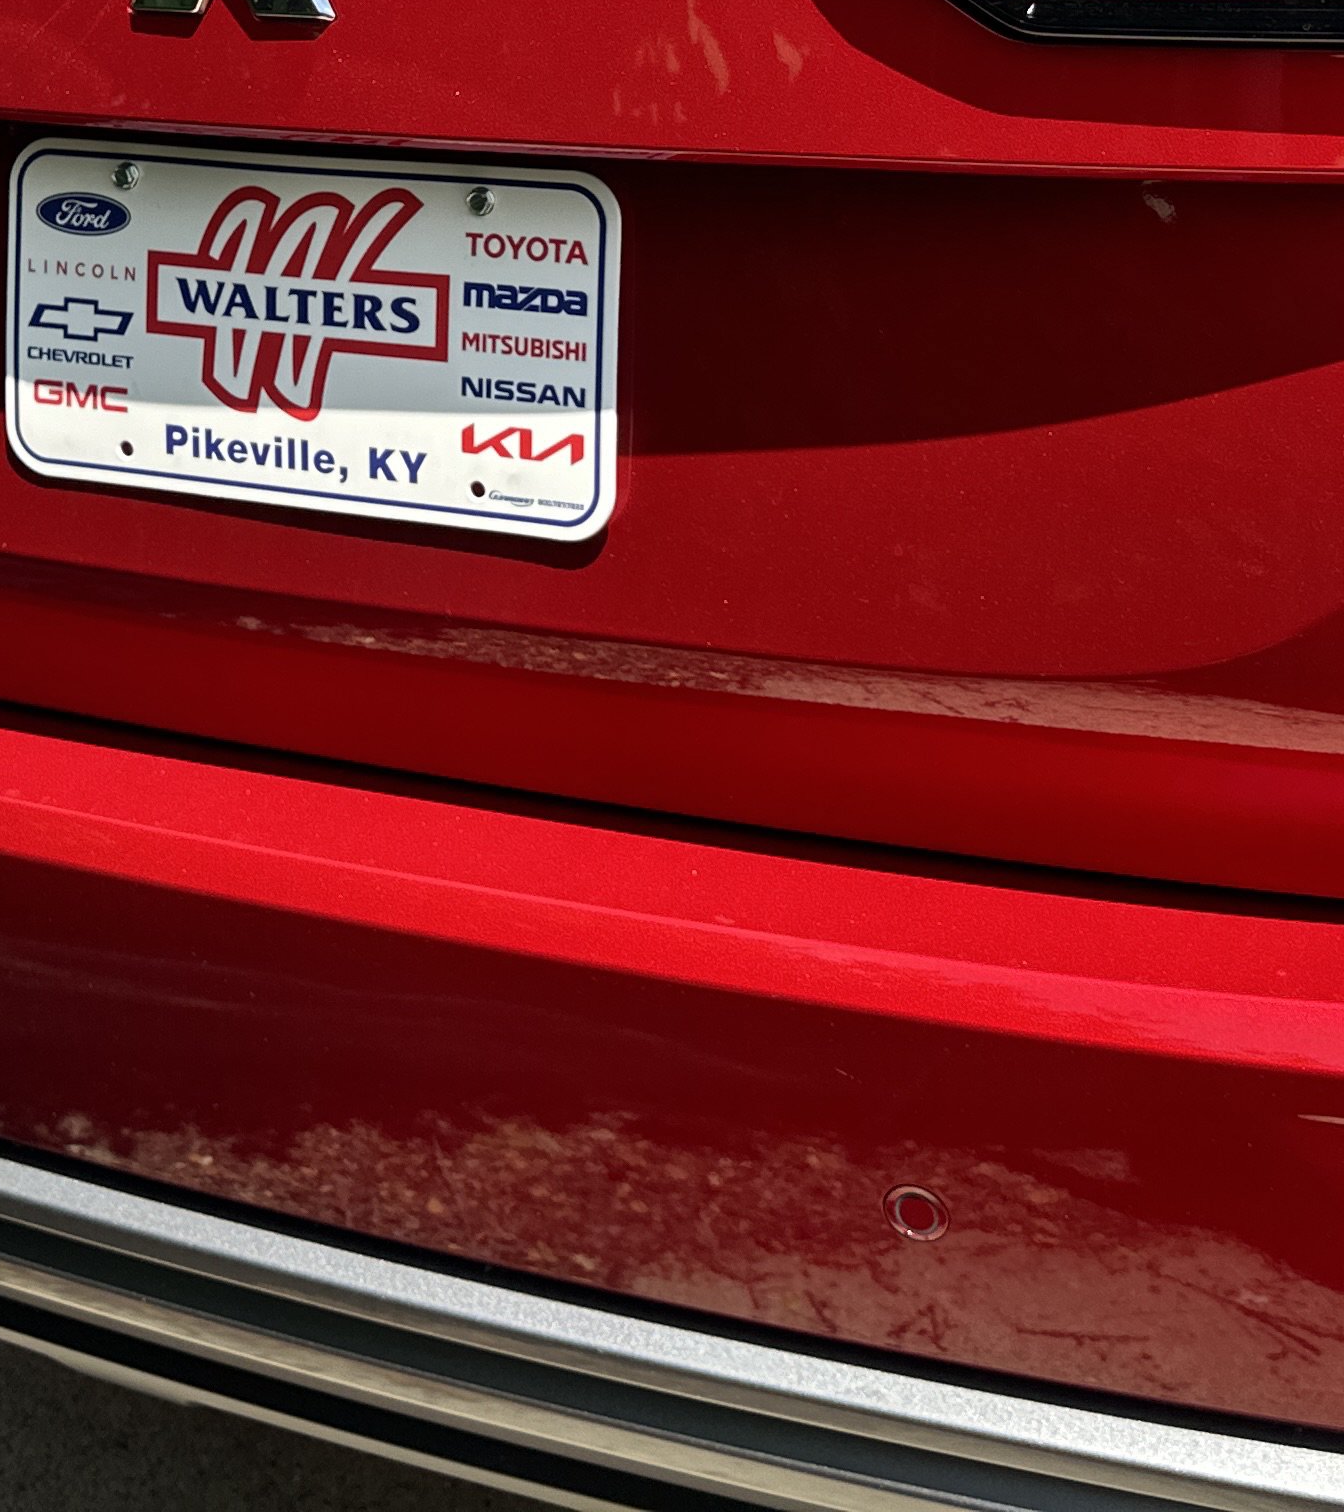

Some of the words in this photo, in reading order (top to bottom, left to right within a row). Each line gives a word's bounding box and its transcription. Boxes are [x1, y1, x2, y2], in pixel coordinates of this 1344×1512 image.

[56, 199, 112, 229] Ford
[465, 232, 589, 266] TOYOTA
[27, 258, 136, 282] LINCOLN
[175, 276, 421, 334] WALTERS
[27, 346, 134, 369] CHEVROLET
[462, 332, 587, 362] MITSUBISHI
[33, 378, 129, 413] GMC
[461, 376, 586, 409] NISSAN
[165, 423, 349, 483] Pikeville,
[368, 446, 427, 484] KY
[461, 423, 584, 466] KIA
